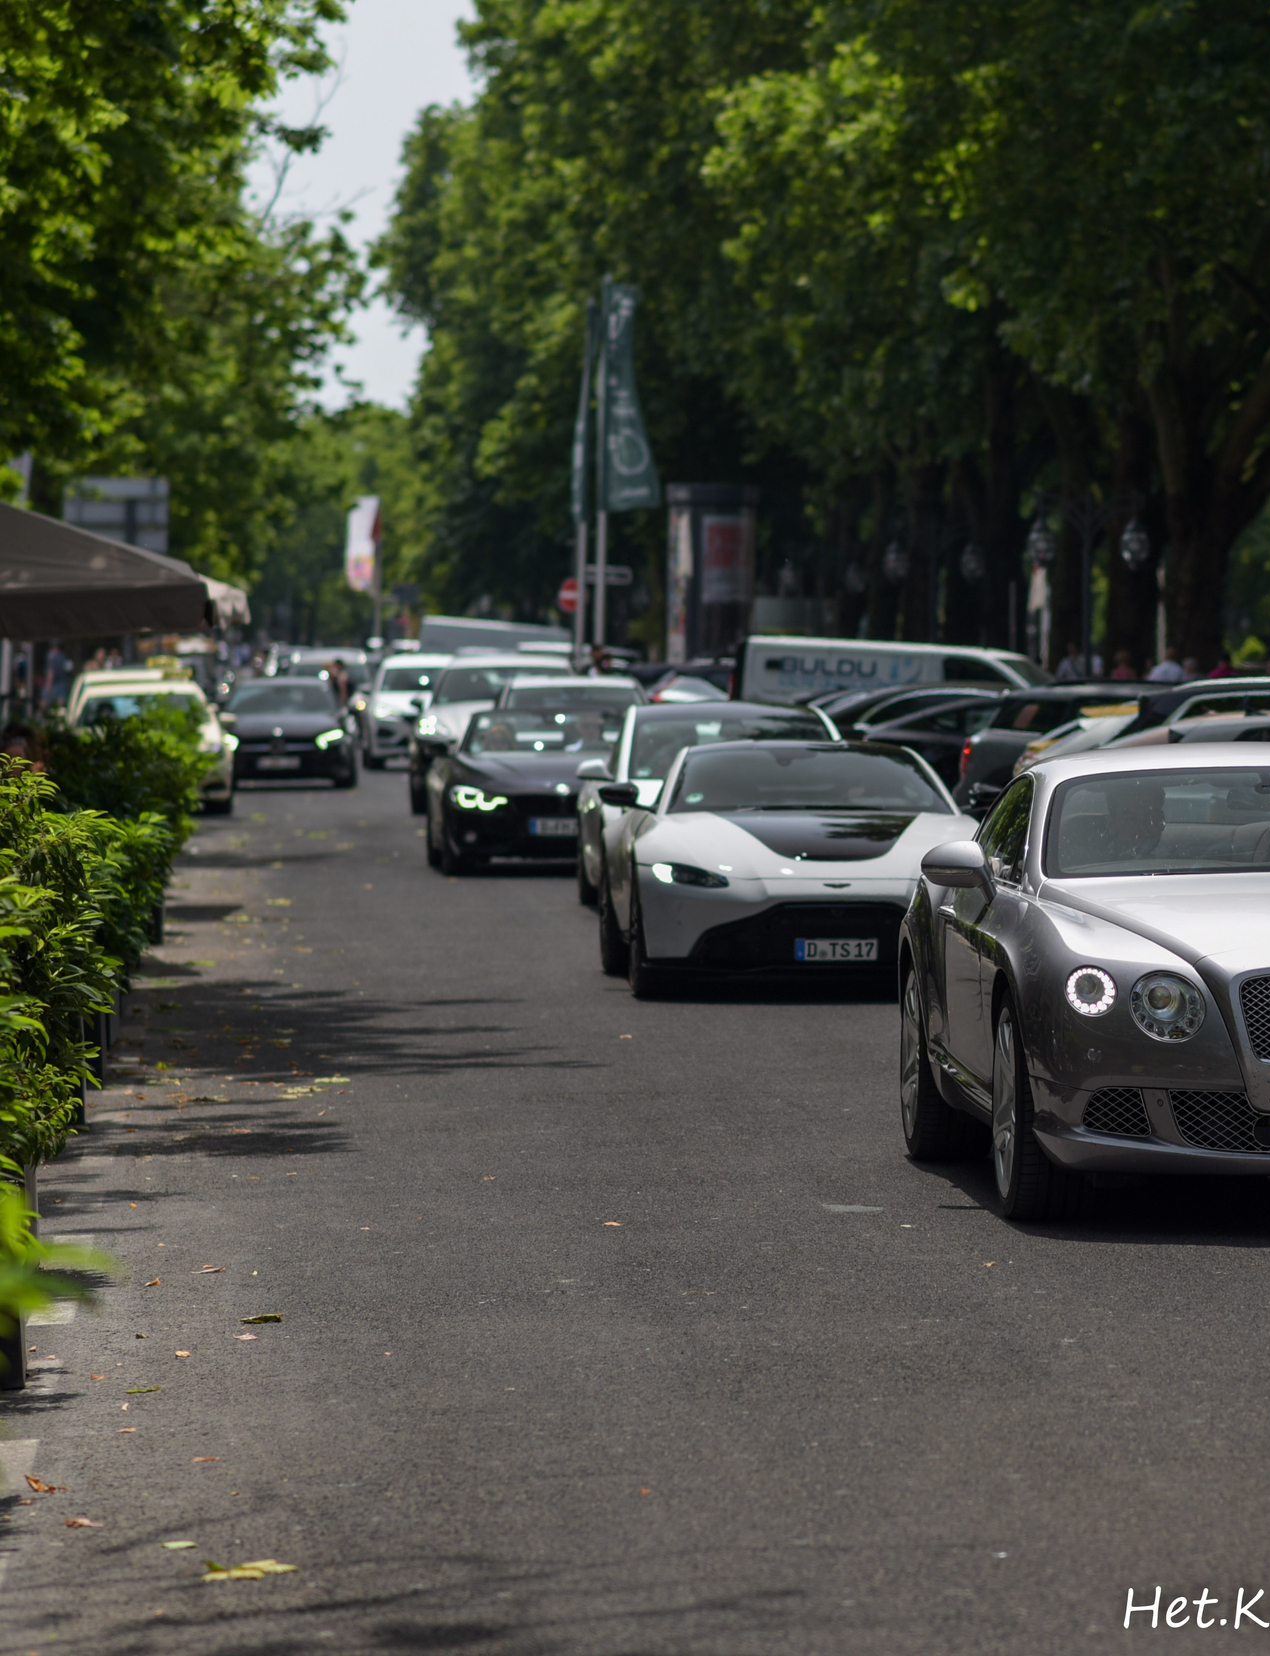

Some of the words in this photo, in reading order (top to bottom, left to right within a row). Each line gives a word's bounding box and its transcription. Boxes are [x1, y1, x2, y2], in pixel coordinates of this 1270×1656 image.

[780, 656, 878, 678] BULDU
[807, 942, 818, 958] D
[829, 942, 851, 958] TS
[854, 942, 875, 958] 17
